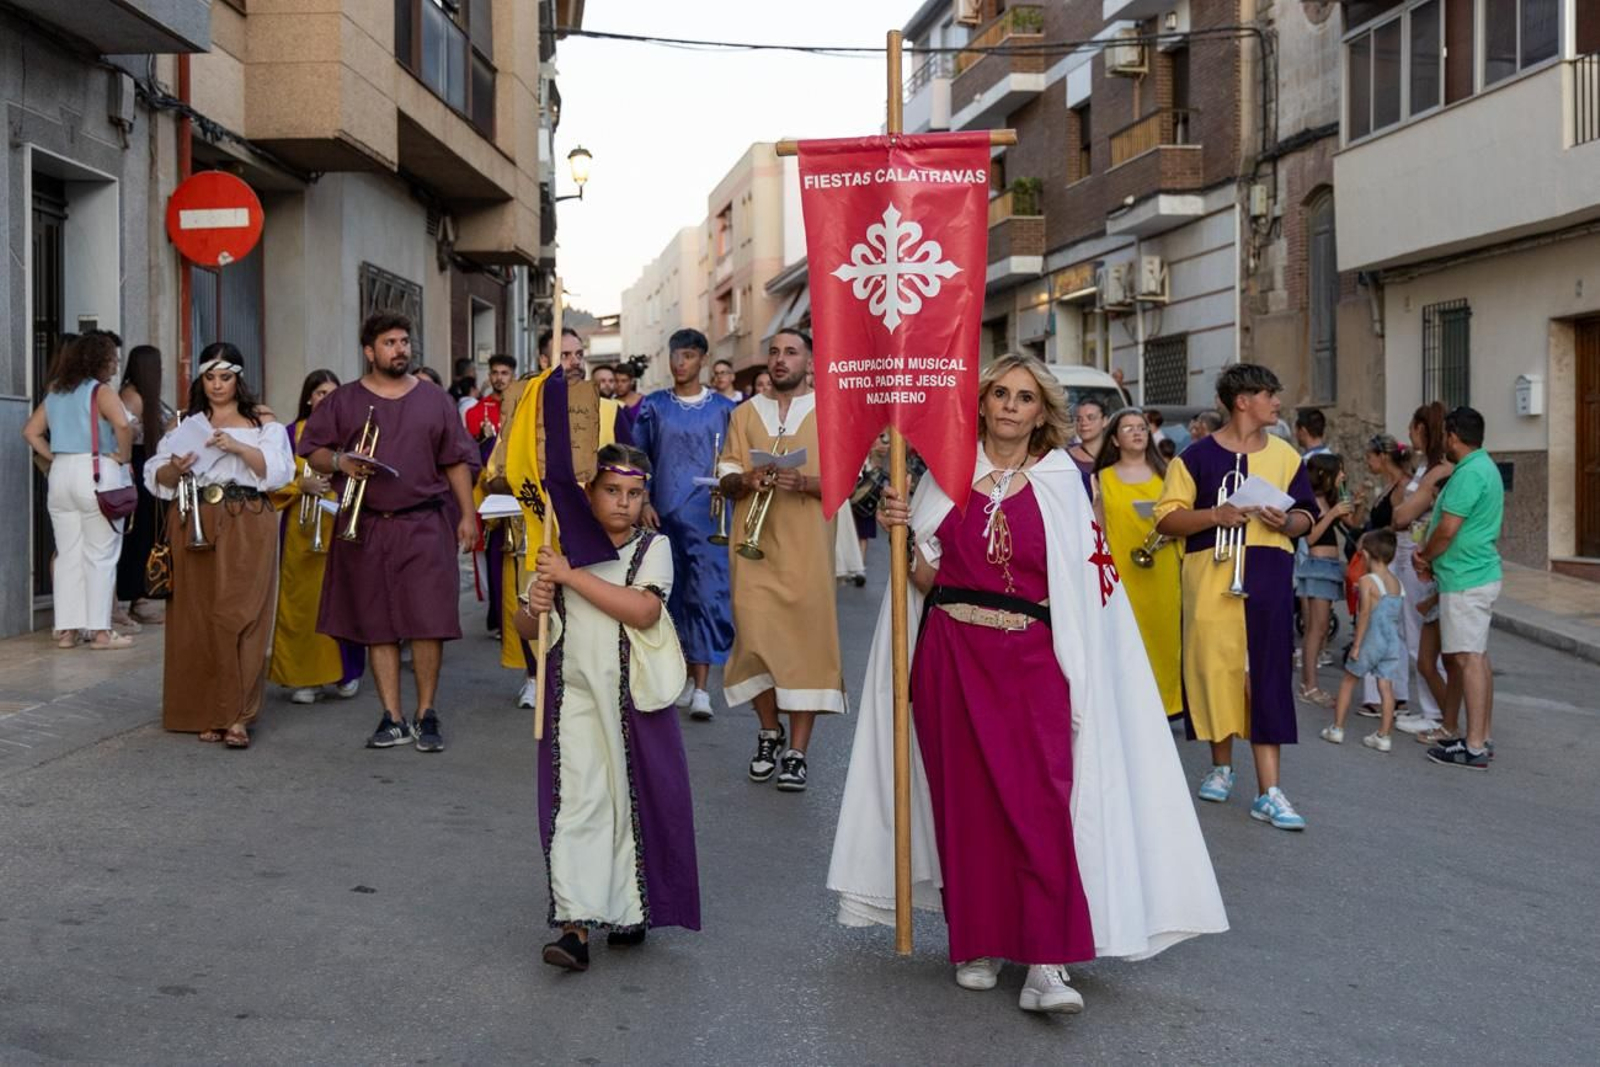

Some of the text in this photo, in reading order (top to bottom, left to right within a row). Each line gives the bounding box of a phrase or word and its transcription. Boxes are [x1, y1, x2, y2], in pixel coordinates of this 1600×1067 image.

[804, 168, 986, 189] FIESTAS CALATRAVAS
[828, 355, 967, 374] AGRUPACIÓN MUSICAL
[839, 372, 956, 390] NTRO. PADRE JESÚS
[867, 391, 926, 405] NAZARENO
